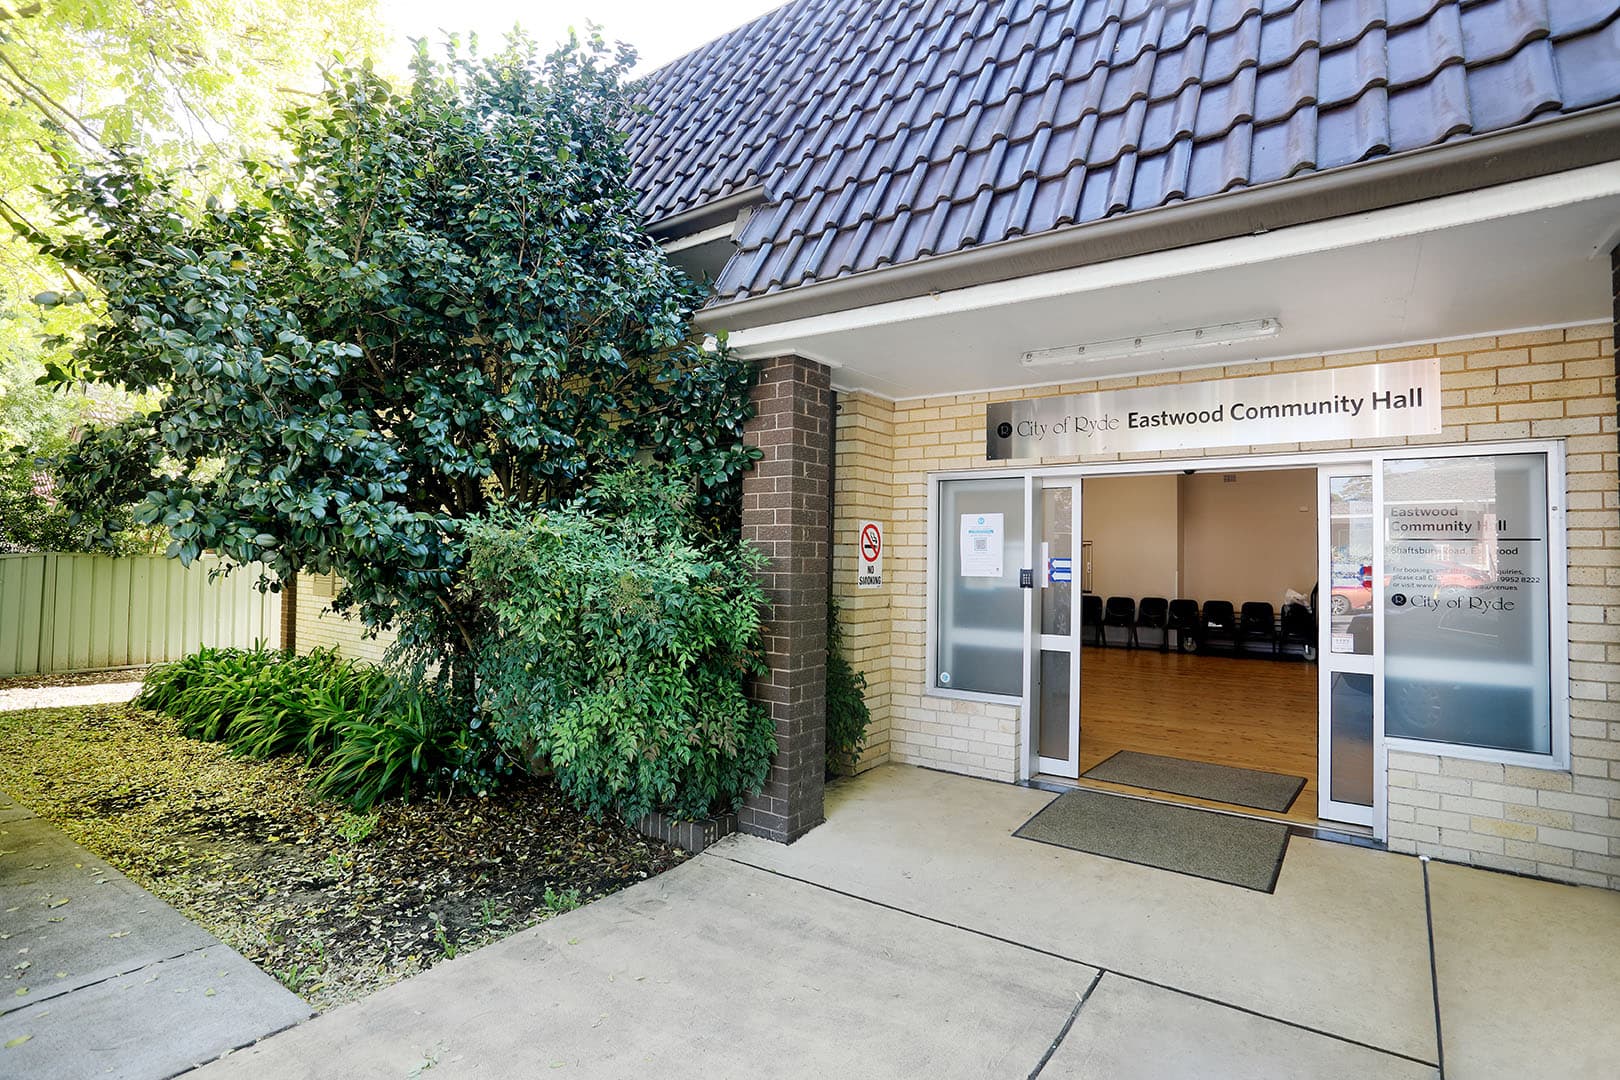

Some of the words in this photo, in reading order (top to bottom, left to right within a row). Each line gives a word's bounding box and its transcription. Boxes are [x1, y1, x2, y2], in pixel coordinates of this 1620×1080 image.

[1017, 420, 1047, 440] City
[1053, 415, 1070, 434] of
[1075, 414, 1119, 437] Ryde
[1128, 405, 1223, 428] Eastwood
[1230, 395, 1364, 420] Community
[1372, 387, 1422, 410] Hall
[1391, 506, 1458, 517] Eastwood
[1391, 520, 1472, 533] Community
[1477, 519, 1506, 531] Hll
[1391, 546, 1442, 557] Shaftsbur
[1471, 547, 1518, 555] Eood
[867, 565, 874, 574] NO
[859, 575, 881, 585] SMOKING
[1411, 594, 1441, 612] City
[1447, 595, 1464, 608] of
[1469, 596, 1515, 614] Ryde
